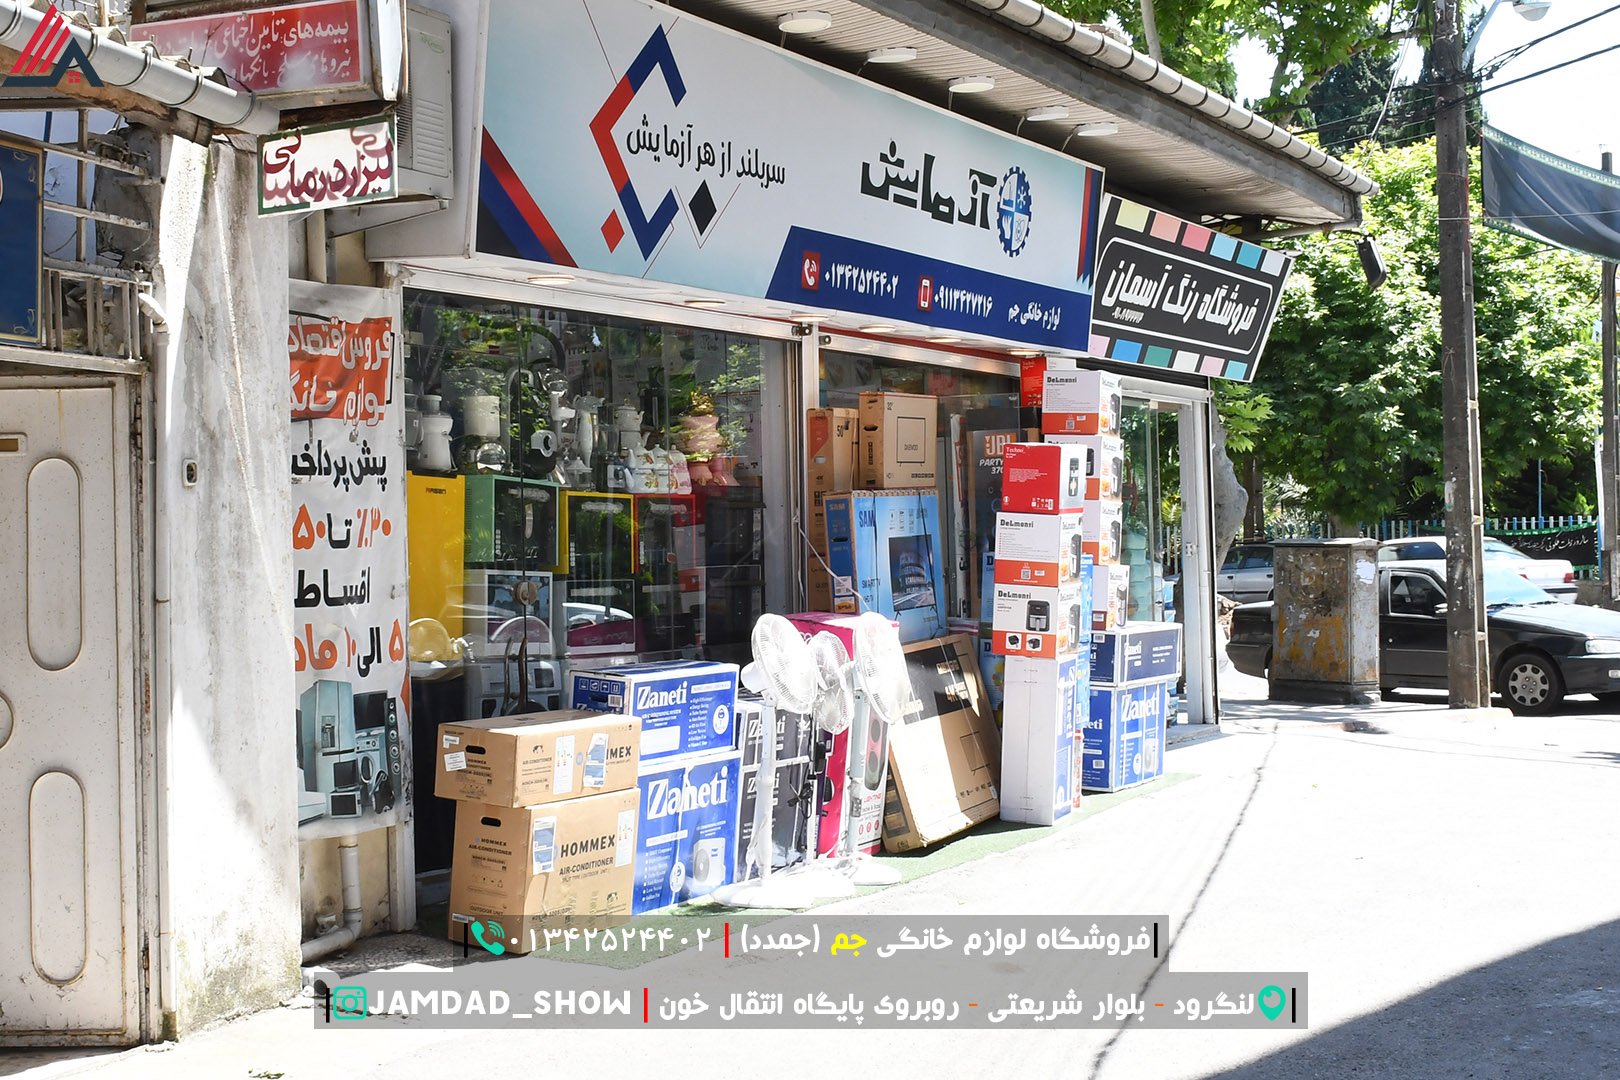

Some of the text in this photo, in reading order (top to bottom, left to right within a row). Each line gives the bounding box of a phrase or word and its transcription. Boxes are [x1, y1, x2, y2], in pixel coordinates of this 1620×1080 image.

[626, 114, 786, 189] سربلند از هر آزمایش
[860, 138, 998, 231] آزمایش
[1008, 301, 1061, 331] لوازم خانگی جم
[1101, 260, 1260, 335] فروشگاه رنگ آسمان
[290, 370, 338, 412] خانگ
[327, 513, 353, 549] تا
[294, 566, 371, 608] اقساط
[357, 626, 382, 678] الی
[388, 618, 405, 662] ۵
[637, 680, 688, 711] Zaneti
[1121, 690, 1160, 722] Zaneti
[606, 746, 632, 760] MEX
[646, 765, 729, 821] Zaneti
[559, 856, 614, 876] AIR-CONDITIONER
[560, 834, 616, 859] HOMMEX
